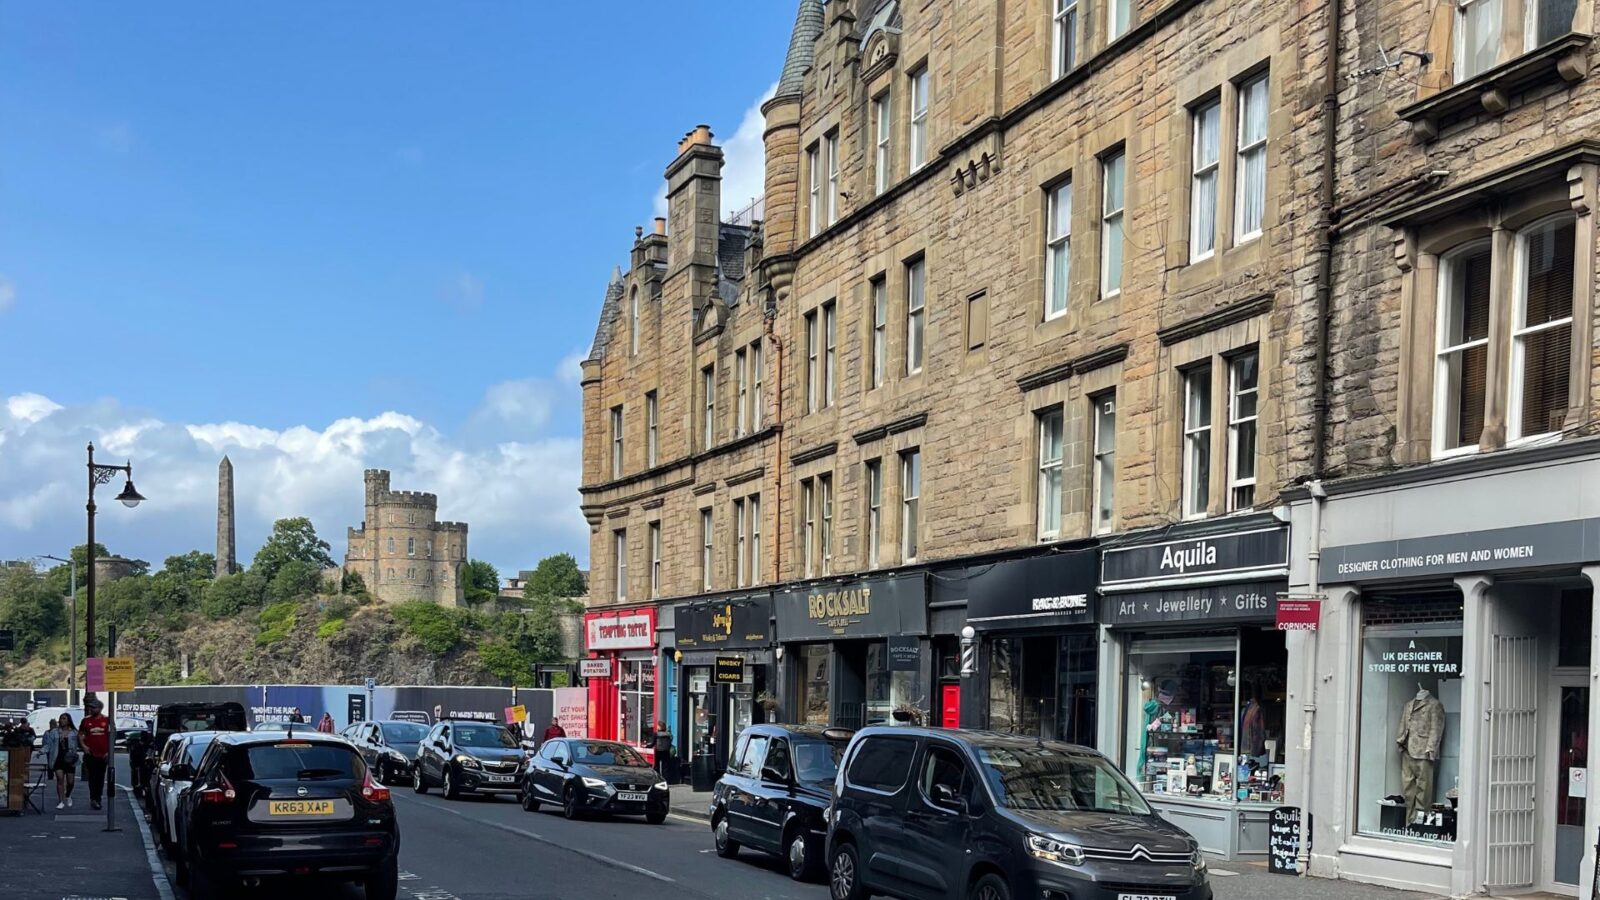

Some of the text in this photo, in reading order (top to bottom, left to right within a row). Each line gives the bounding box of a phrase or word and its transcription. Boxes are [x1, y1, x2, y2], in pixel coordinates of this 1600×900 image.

[1160, 542, 1216, 573] Aquila
[1338, 546, 1534, 574] DESIGNER CLOTHING FOR MEN AND WOMEN
[808, 588, 870, 618] ROCKSALT
[1119, 593, 1268, 615] Art Jewellery Gifts
[1278, 622, 1317, 631] CORNICHE
[1408, 640, 1416, 649] A
[1382, 652, 1443, 661] UK DESIGNER
[1368, 663, 1457, 672] STORE OF THE YEAR
[274, 801, 329, 813] KR63 XAP
